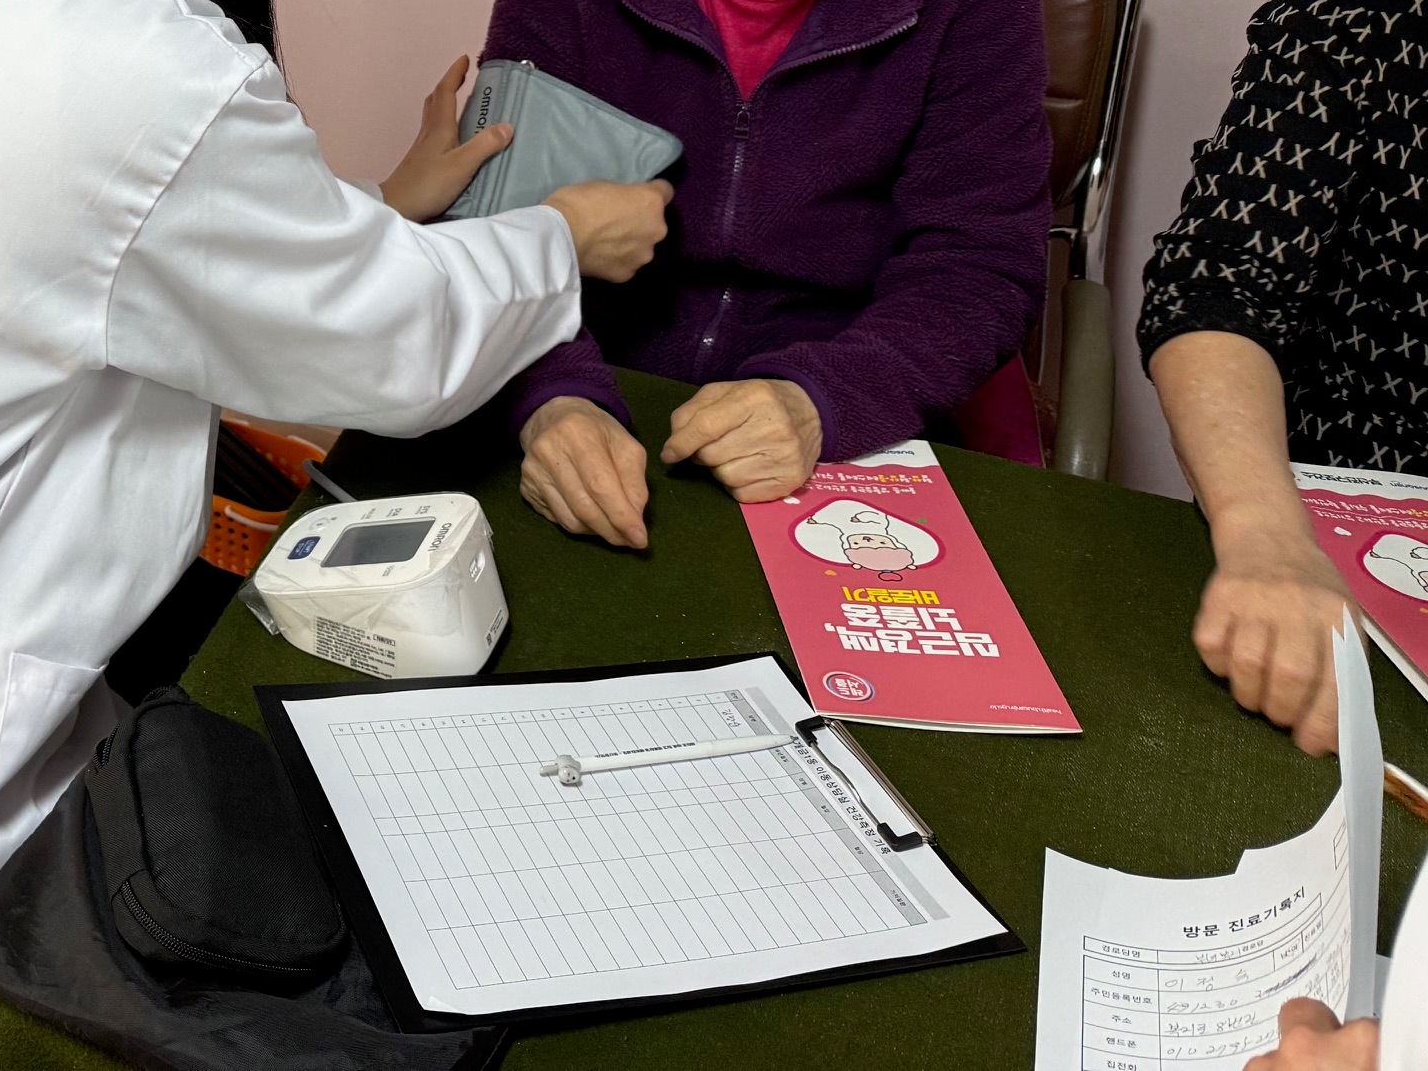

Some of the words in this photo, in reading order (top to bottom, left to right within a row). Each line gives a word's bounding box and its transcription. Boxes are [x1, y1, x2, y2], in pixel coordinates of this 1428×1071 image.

[428, 522, 452, 552] OMRON
[841, 586, 940, 605] 바로알기
[840, 602, 963, 631] 뇌졸중
[824, 623, 1000, 658] 심근경색,
[836, 685, 864, 698] 레드
[846, 806, 875, 837] 건강측정
[874, 838, 891, 855] 기록
[1183, 924, 1220, 939] 방문
[1228, 886, 1306, 933] 진료기록지
[1102, 944, 1141, 959] 경로당명
[1111, 971, 1131, 980] 성명
[1090, 988, 1153, 1005] 주민등록번호
[1111, 1016, 1132, 1025] 주소
[1106, 1038, 1137, 1049] 핸드폰
